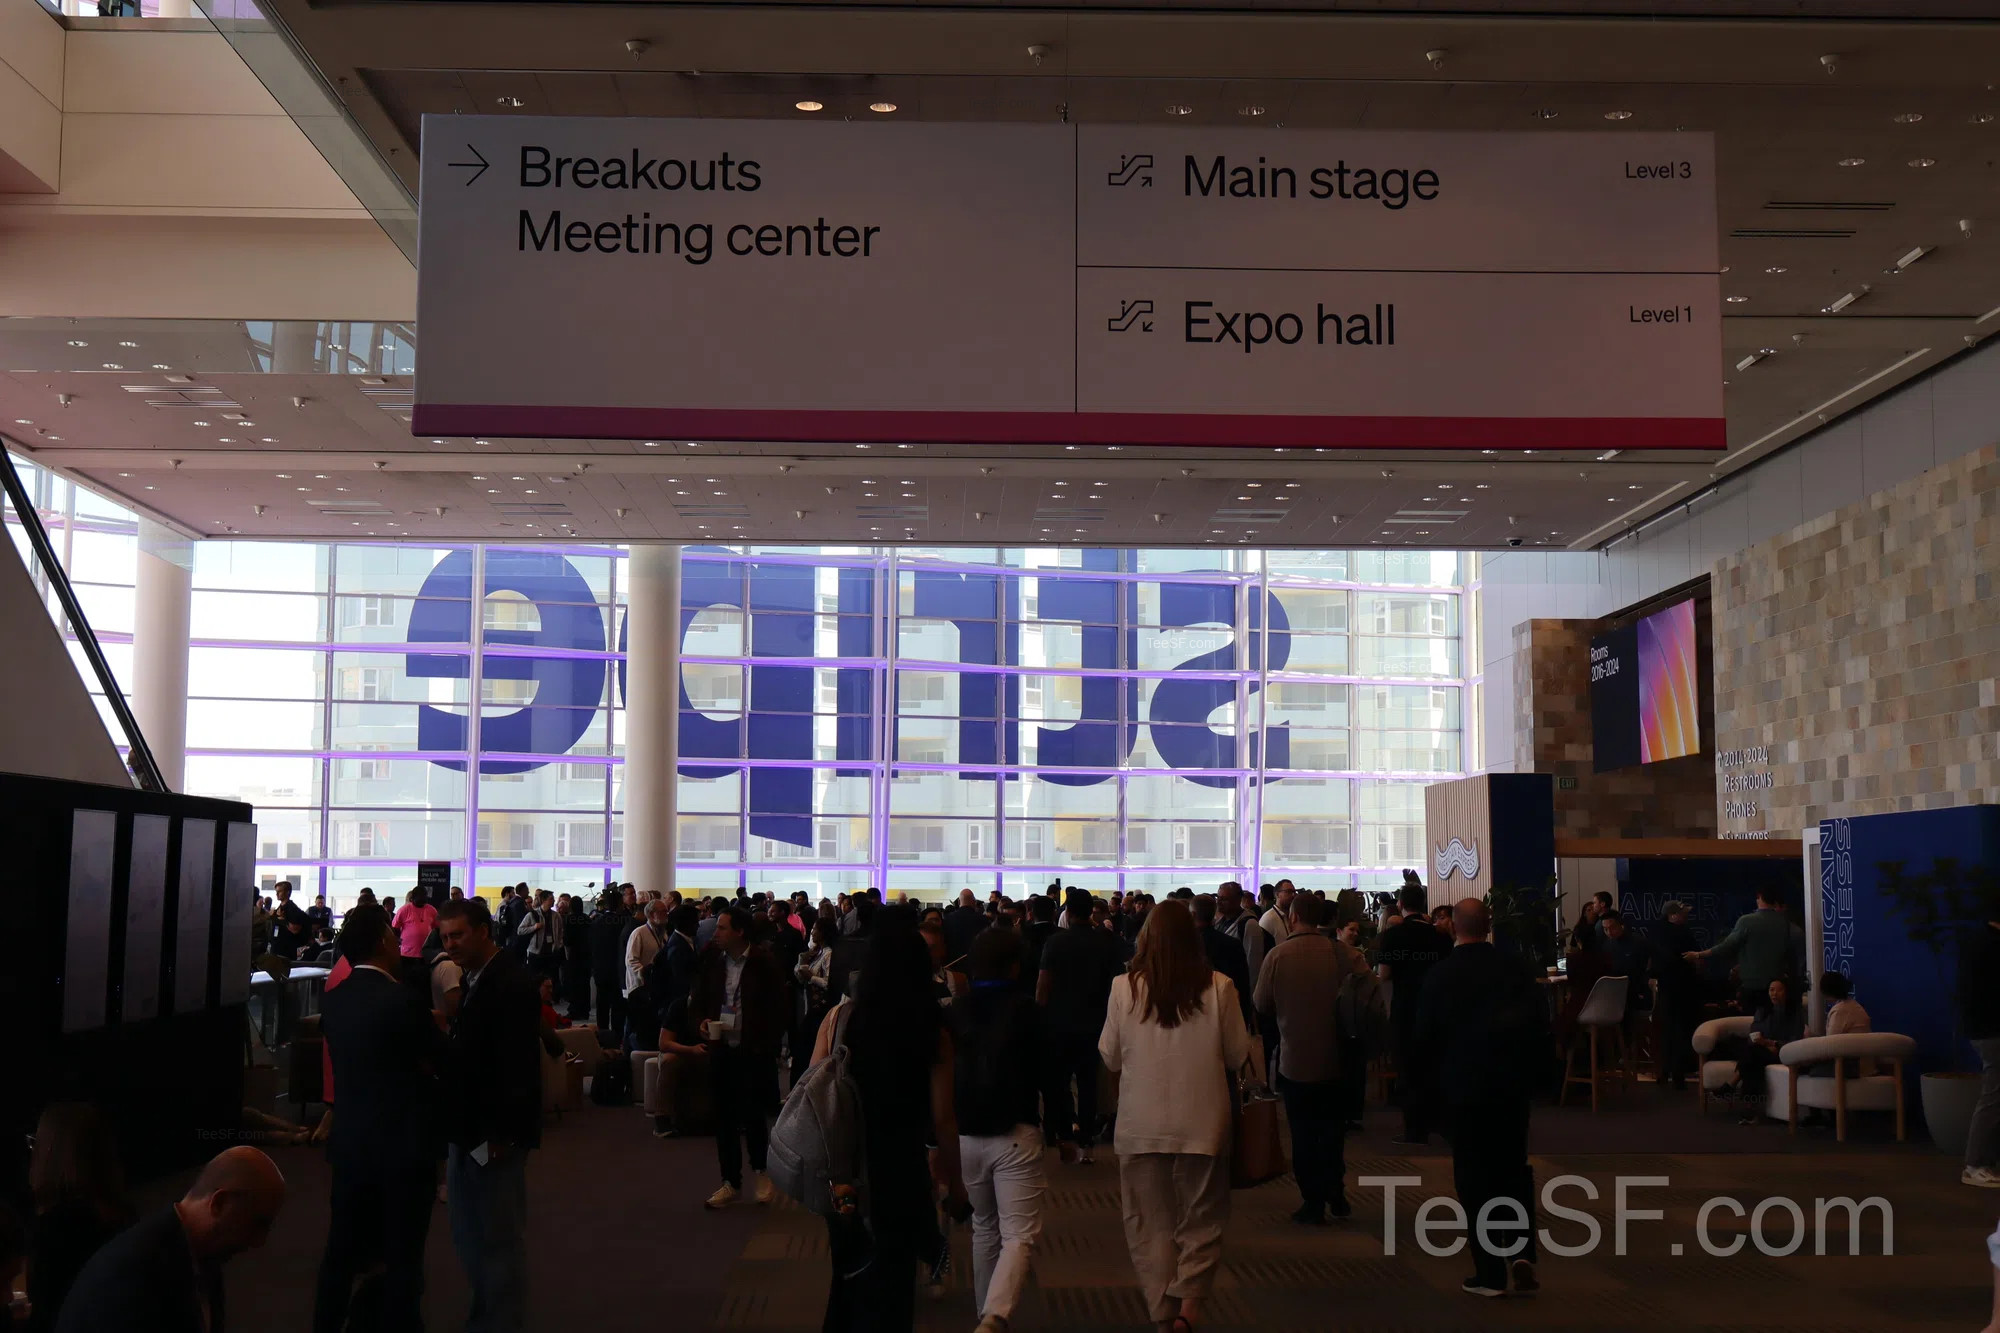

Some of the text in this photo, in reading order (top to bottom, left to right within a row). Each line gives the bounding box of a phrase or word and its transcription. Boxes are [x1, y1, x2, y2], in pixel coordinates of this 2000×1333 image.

[520, 146, 761, 191] Breakouts
[1625, 161, 1692, 179] Level 3
[1185, 155, 1440, 210] Main stage
[519, 210, 881, 265] Meeting center
[1630, 305, 1692, 324] Level 1
[1186, 301, 1395, 353] Expo hall
[1590, 645, 1609, 663] Rooms
[1724, 772, 1773, 793] RESTROOMS
[1725, 801, 1757, 819] PHONES
